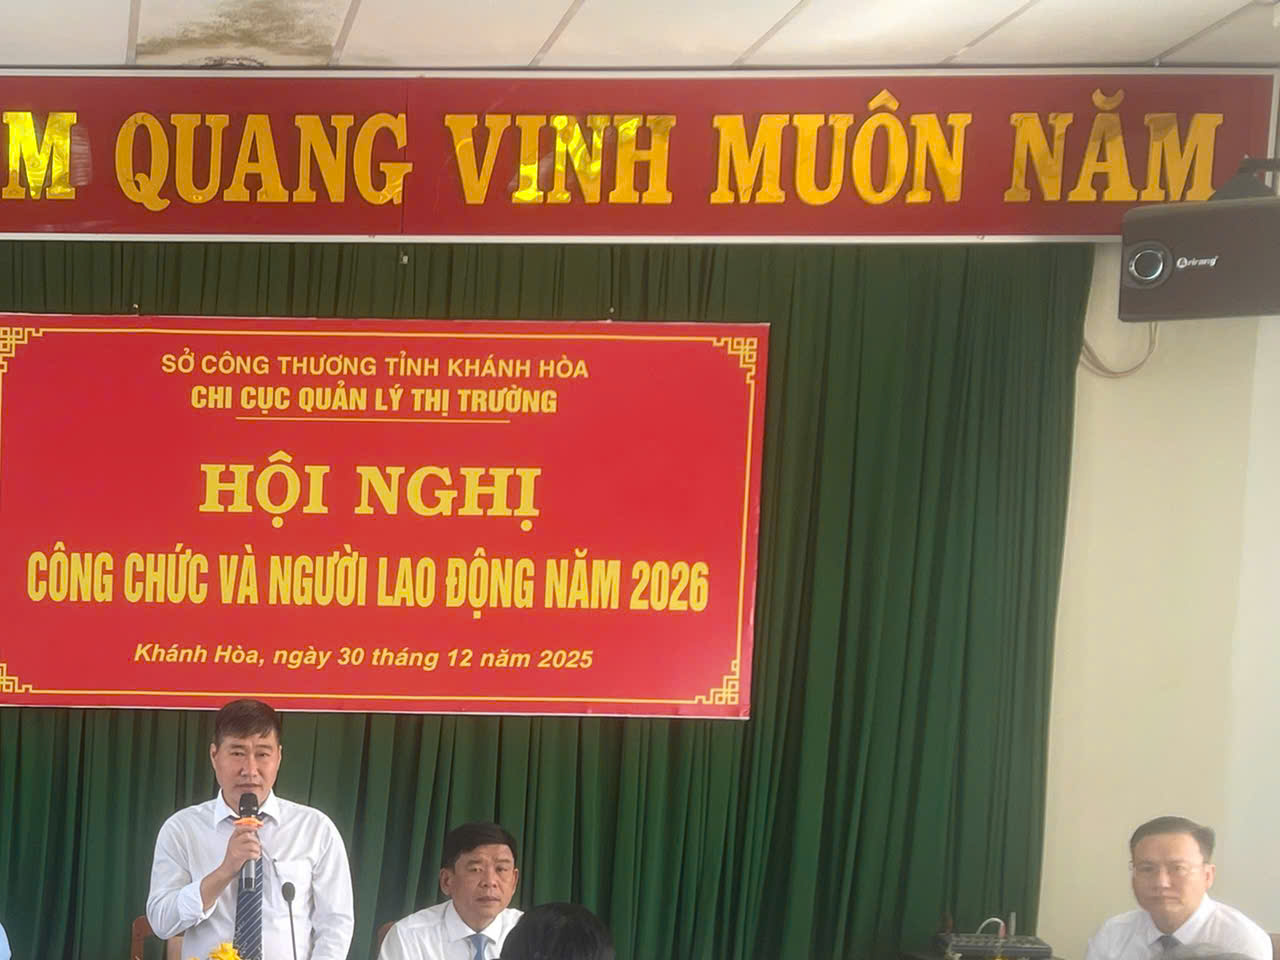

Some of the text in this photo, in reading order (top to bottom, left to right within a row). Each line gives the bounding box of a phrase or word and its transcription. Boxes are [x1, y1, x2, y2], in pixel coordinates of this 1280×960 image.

[115, 112, 414, 212] QUANG
[444, 113, 677, 205] VINH
[710, 88, 973, 206] MUÔN
[1003, 88, 1224, 204] NĂM
[161, 347, 589, 379] SỞ CÔNG THƯƠNG TỈNH KHÁNH HÒA
[190, 379, 558, 417] CHI CỤC QUẢN LÝ THỊ TRƯỜNG
[198, 449, 542, 532] HỘI NGHỊ
[26, 540, 710, 620] CÔNG CHỨC VÀ NGƯỜI LAO ĐỘNG NĂM 2026
[133, 643, 593, 672] Khánh Hòa, ngày 30 tháng 12 năm 2025
